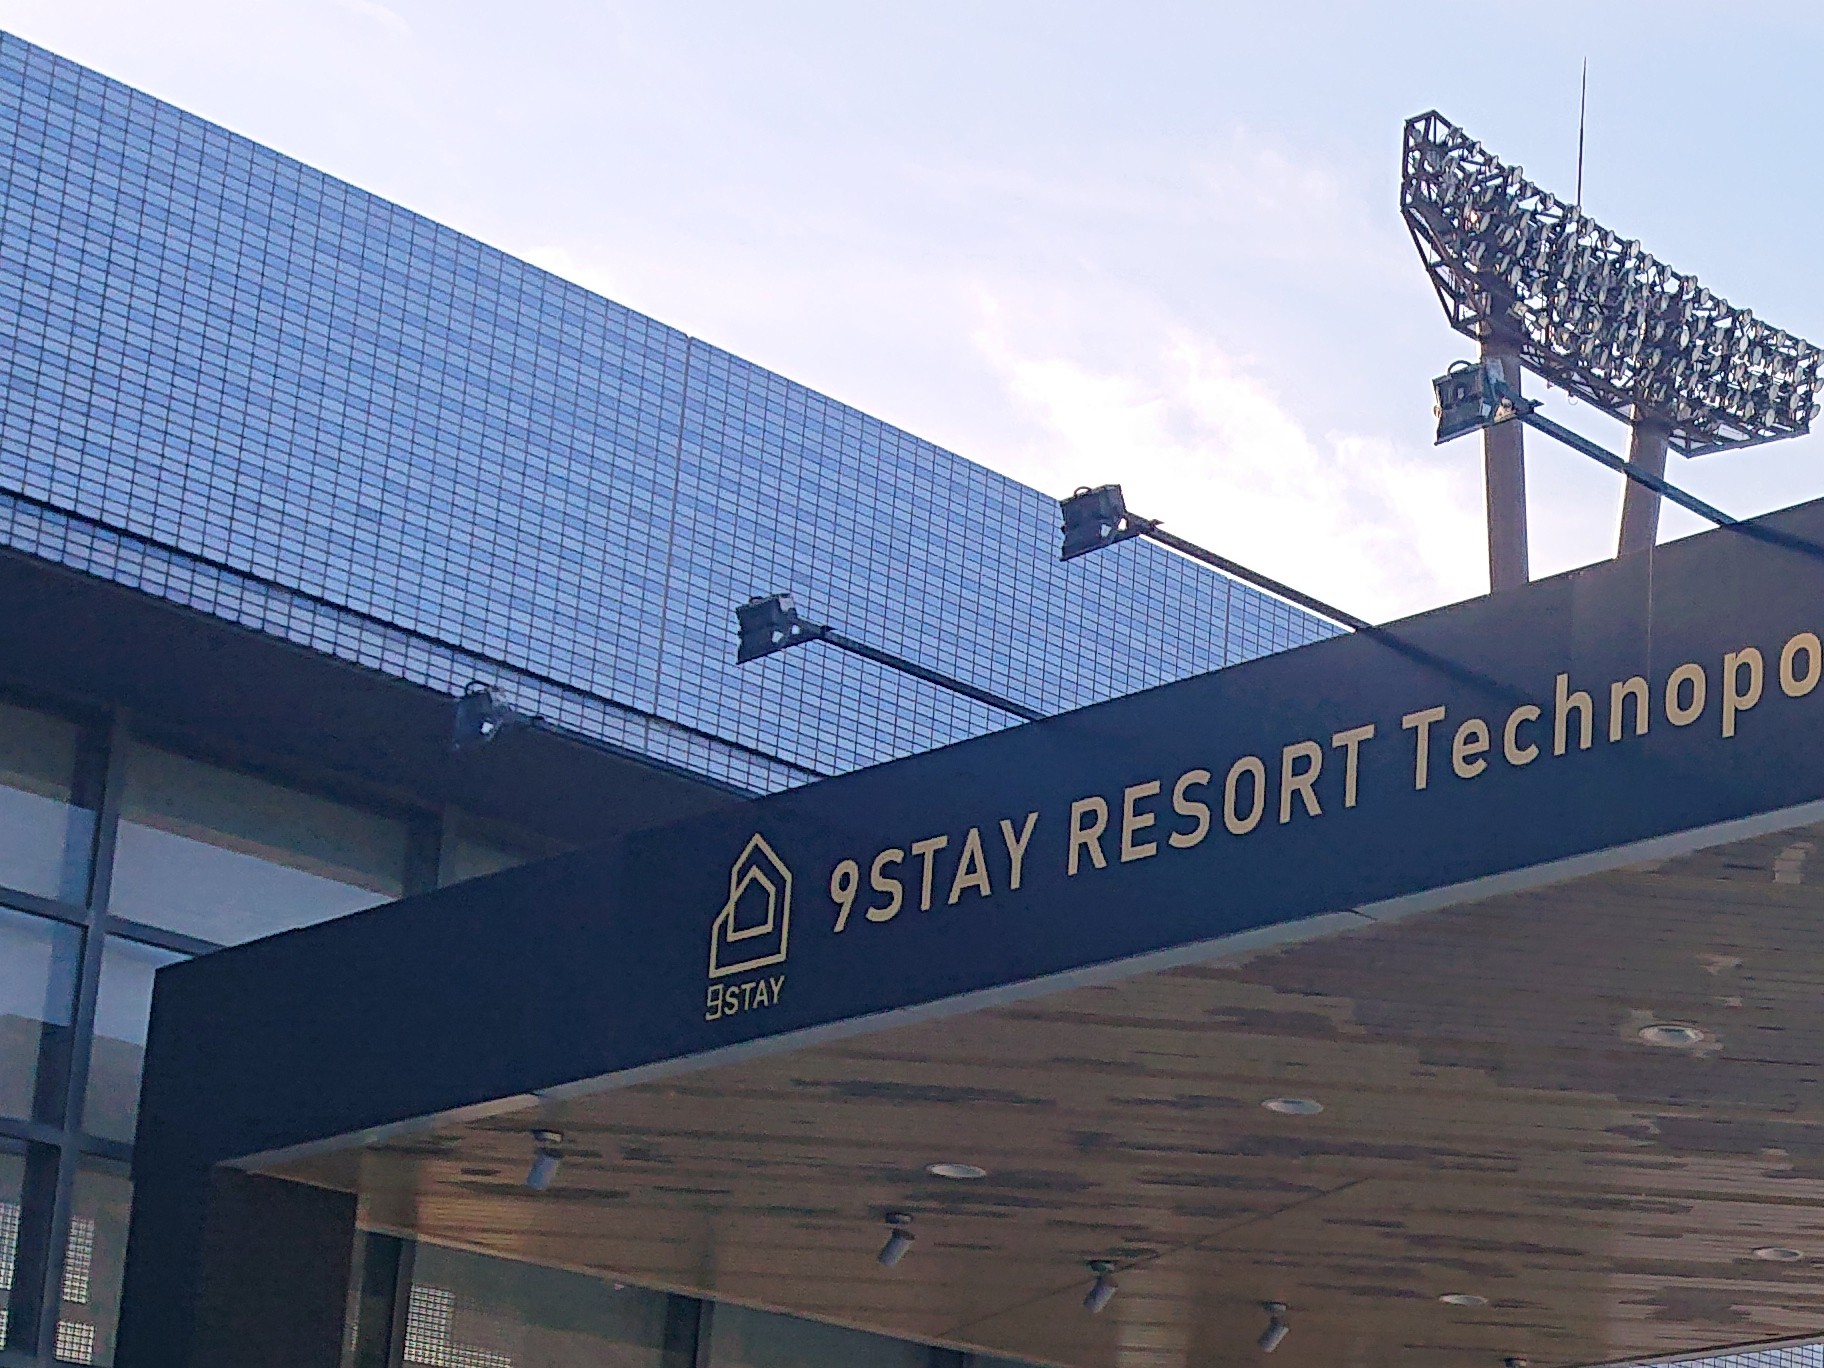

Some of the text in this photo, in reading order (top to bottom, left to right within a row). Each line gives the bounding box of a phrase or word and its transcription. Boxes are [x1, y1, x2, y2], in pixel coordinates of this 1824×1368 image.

[830, 812, 1038, 933] 9STAY
[1067, 723, 1376, 877] RESORT
[704, 974, 786, 1021] 9STAY
